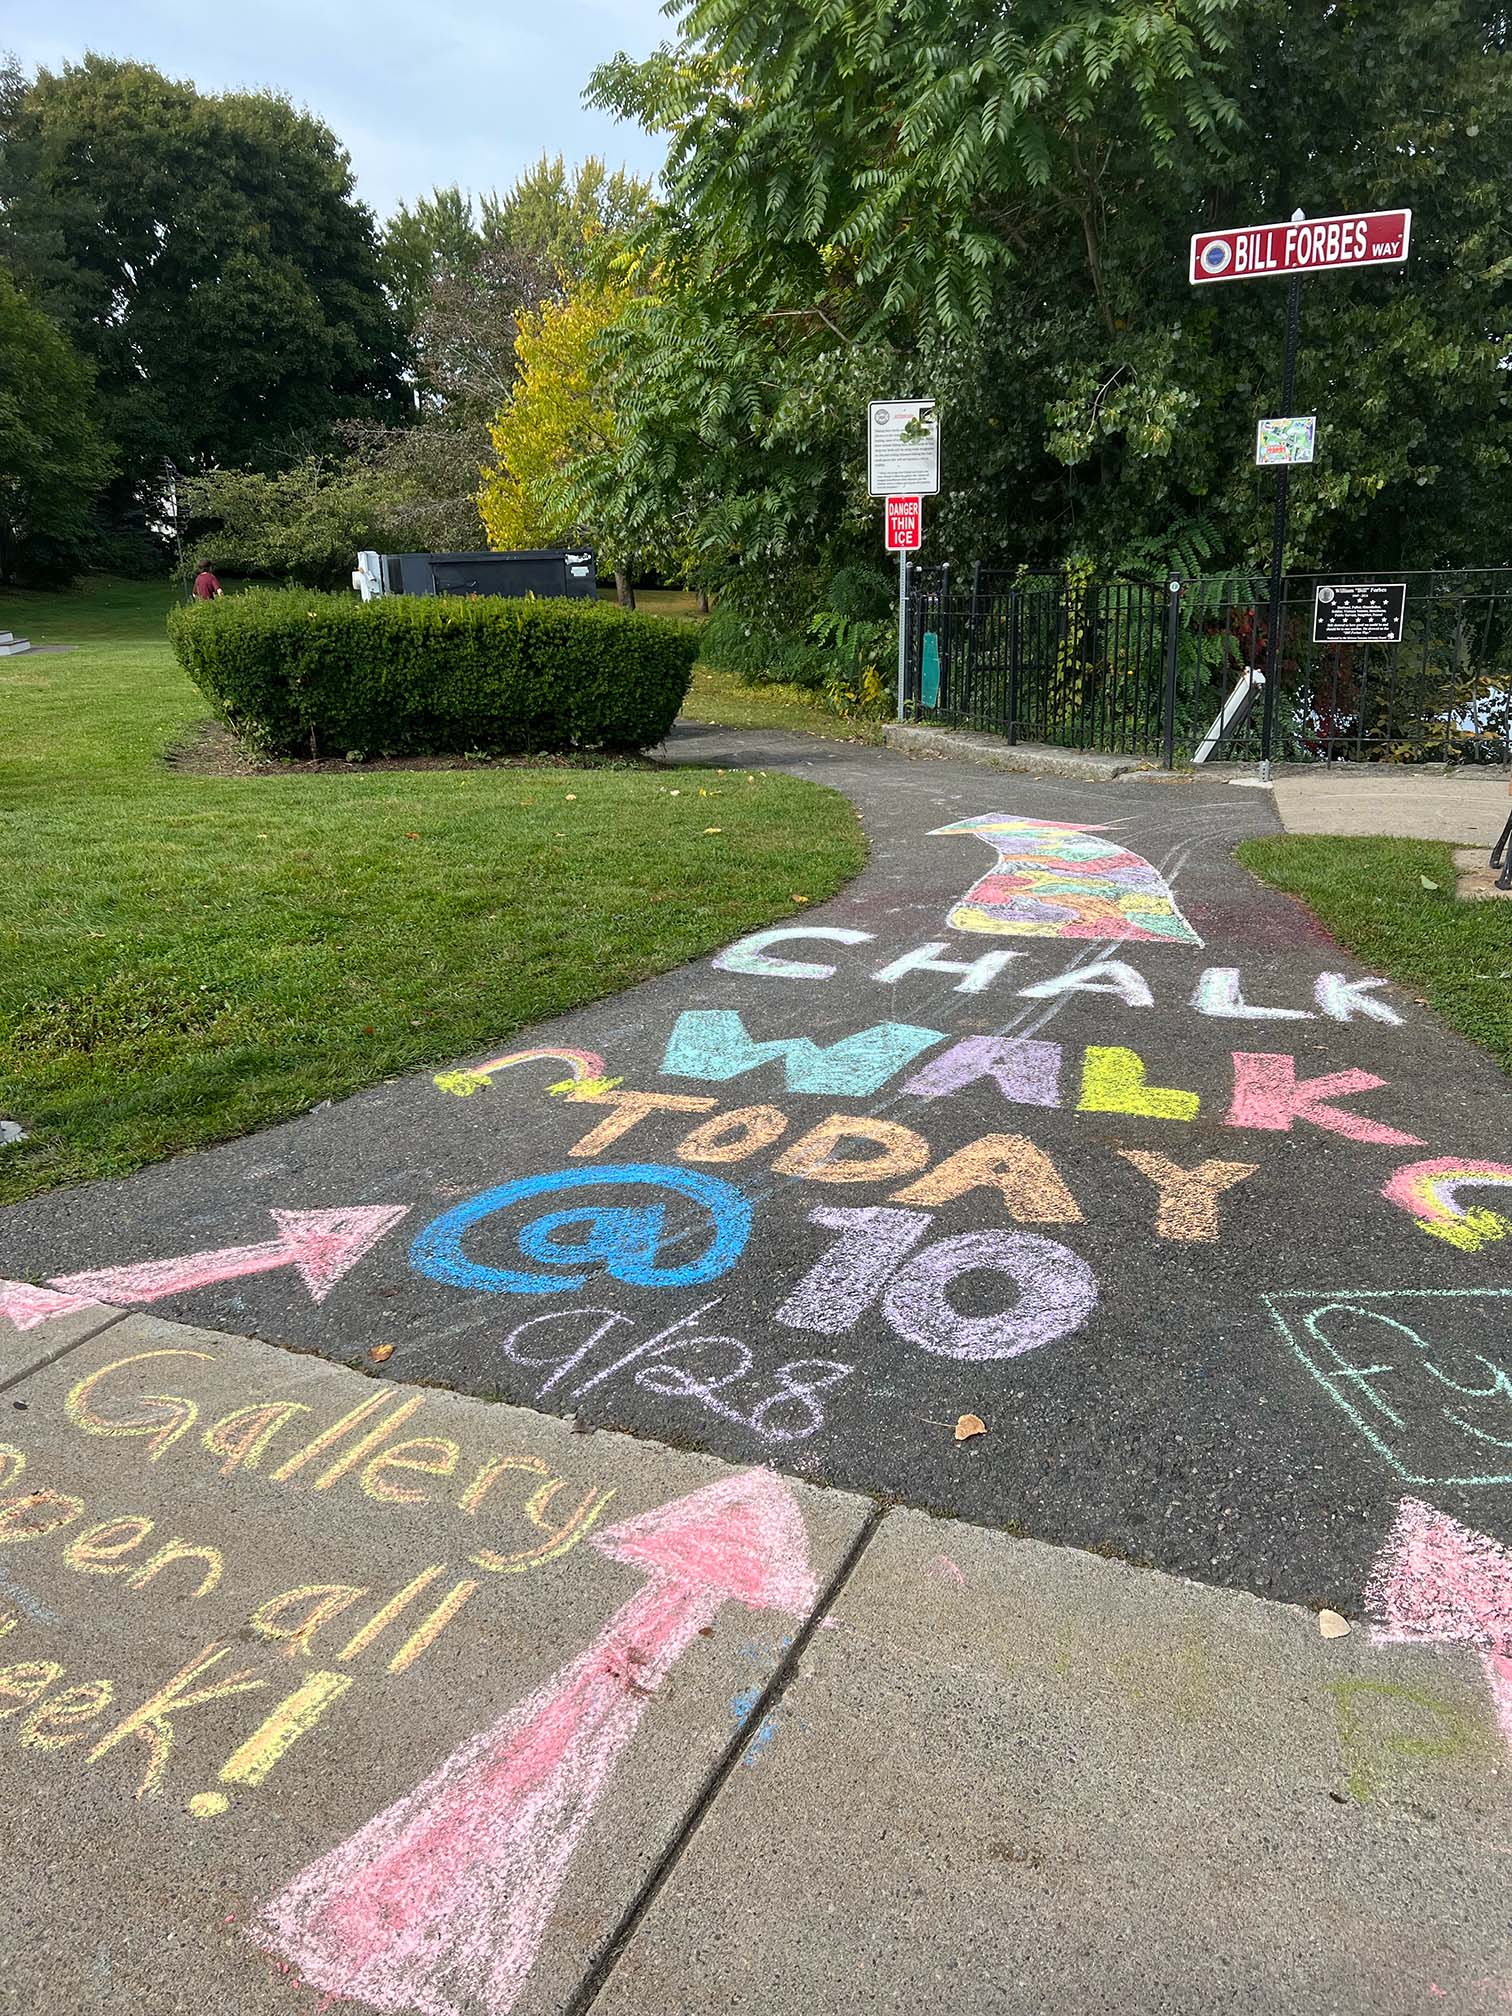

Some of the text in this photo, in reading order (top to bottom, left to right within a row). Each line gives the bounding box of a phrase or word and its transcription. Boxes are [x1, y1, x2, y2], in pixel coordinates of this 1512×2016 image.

[1235, 232, 1277, 272] BILL
[1285, 221, 1368, 266] FORBES
[1372, 241, 1400, 257] WAY
[889, 502, 919, 516] DANGER
[891, 516, 915, 530] THIN
[894, 531, 913, 544] ICE
[711, 926, 1406, 1027] CHALK
[657, 1009, 1430, 1147] WALK
[565, 1090, 1260, 1243] TODAY
[408, 1162, 1099, 1360] @ 10
[503, 1298, 854, 1443] 9/28
[64, 1349, 617, 1574] Gallery
[249, 1563, 478, 1675] all
